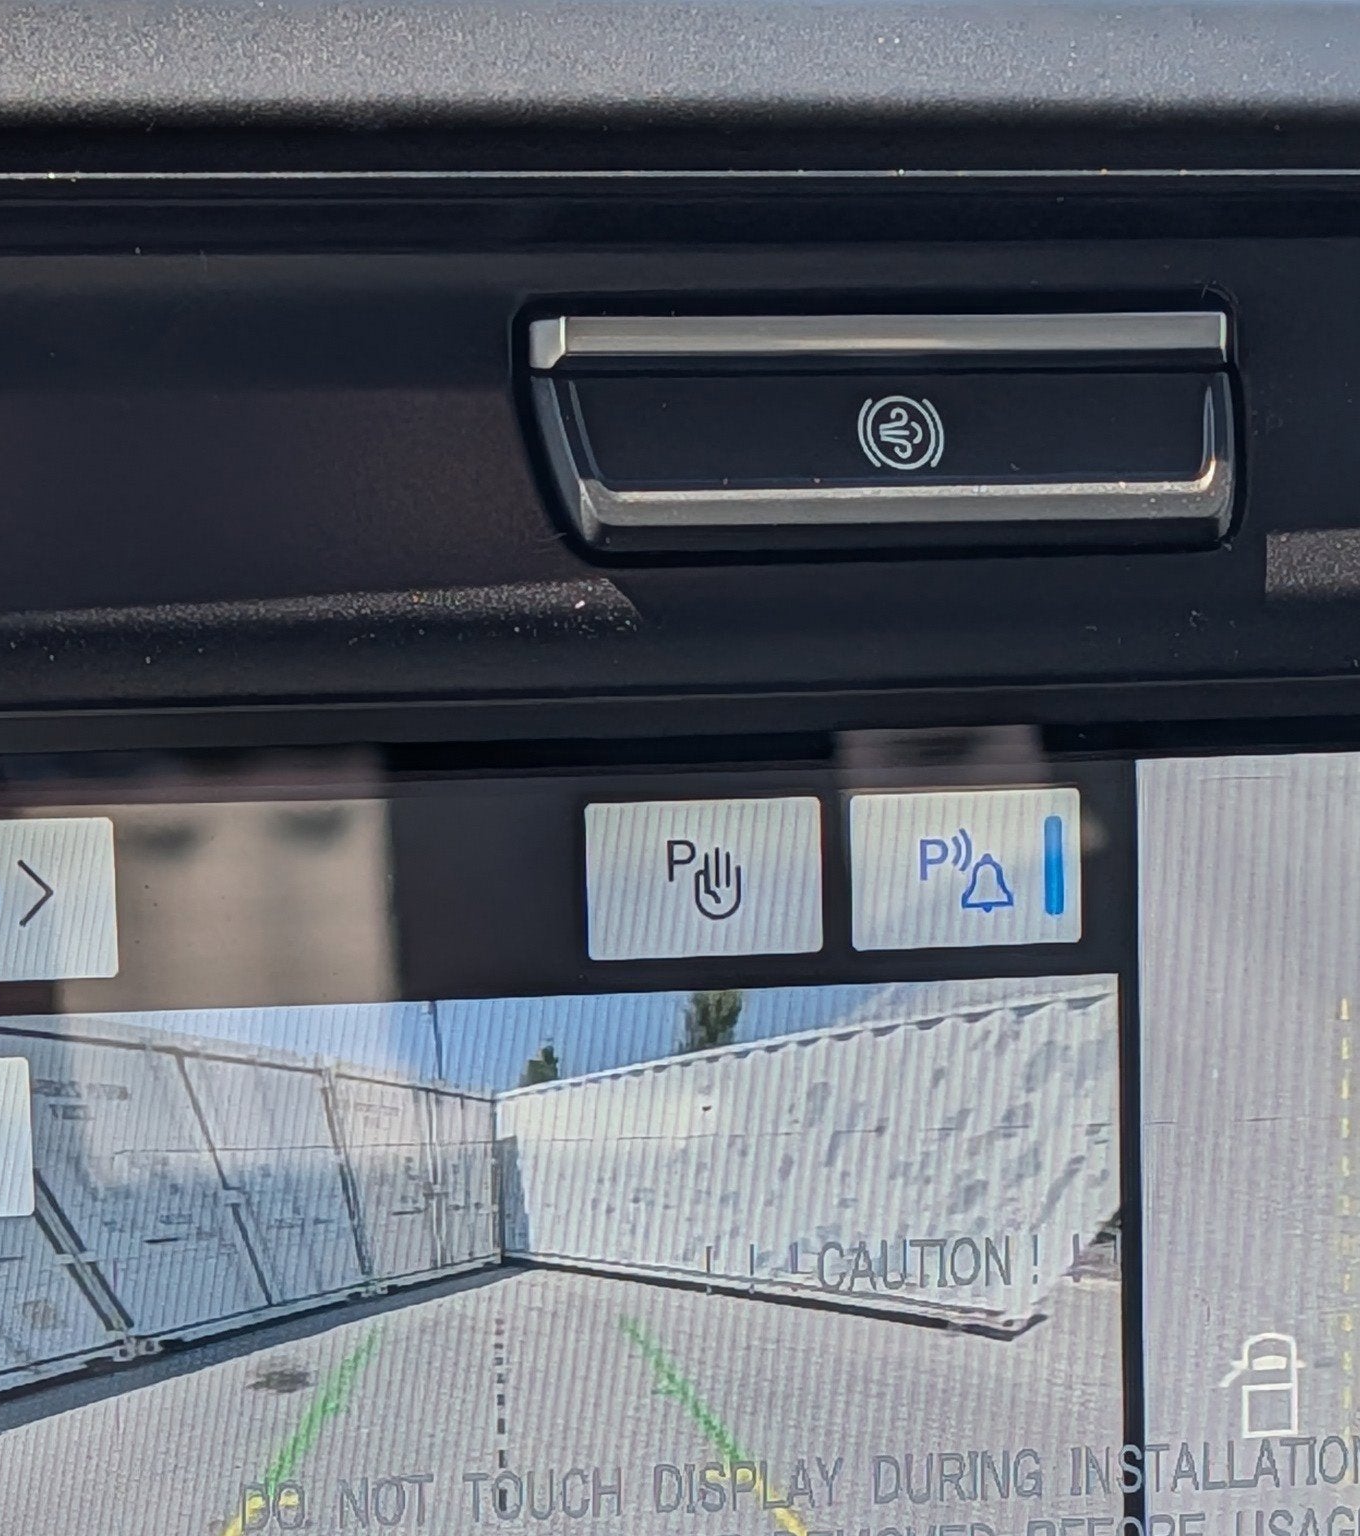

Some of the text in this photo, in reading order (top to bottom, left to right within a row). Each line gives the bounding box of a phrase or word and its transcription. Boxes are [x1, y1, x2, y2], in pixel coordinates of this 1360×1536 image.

[666, 839, 696, 882] P
[919, 838, 947, 881] P
[817, 1236, 1011, 1291] CAUTION
[241, 1480, 307, 1531] DO
[337, 1472, 435, 1529] NOT
[462, 1466, 623, 1522] TOUCH
[653, 1456, 844, 1514] DISPLAY
[872, 1448, 1044, 1506] DURING
